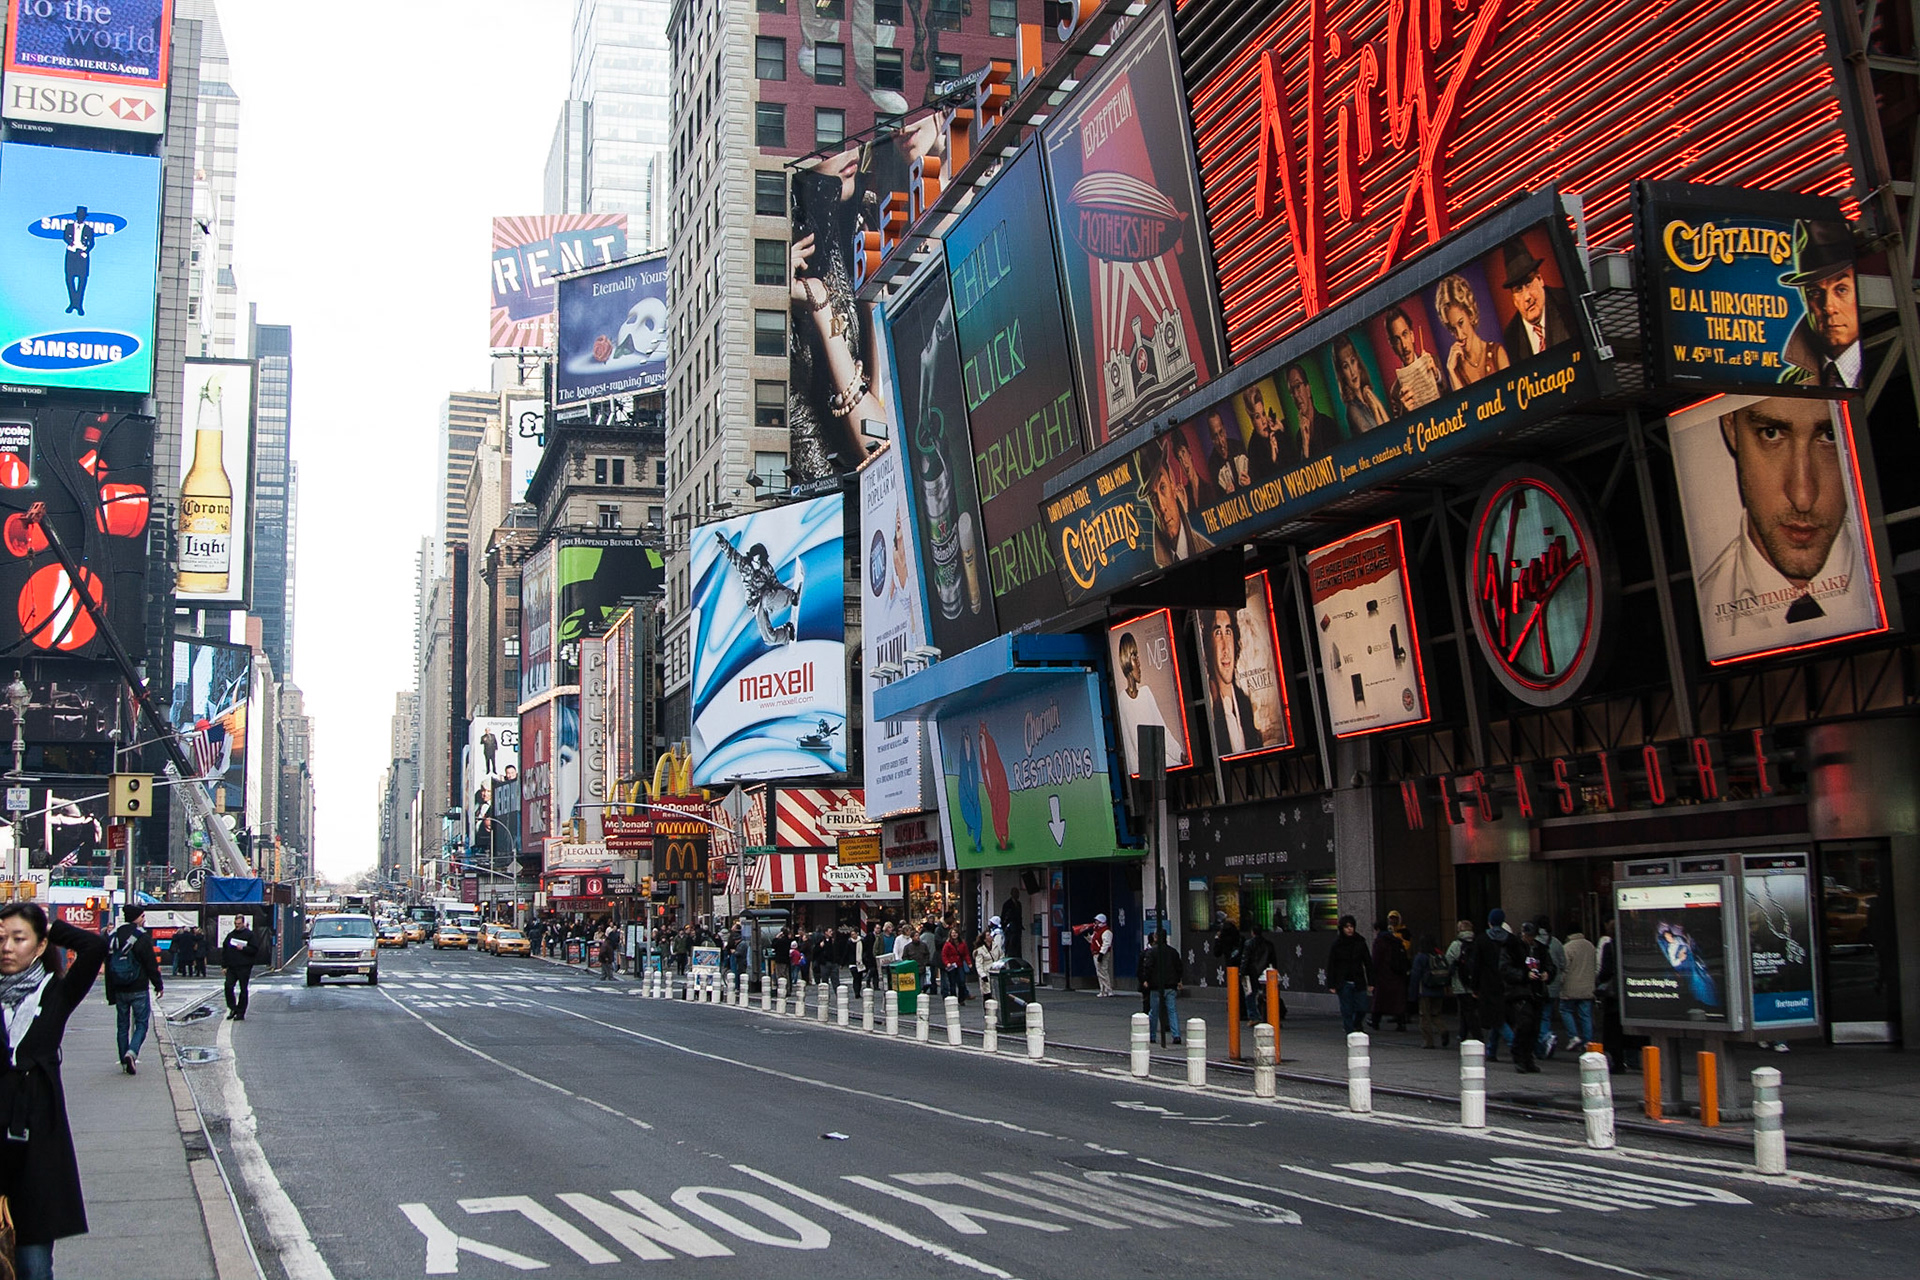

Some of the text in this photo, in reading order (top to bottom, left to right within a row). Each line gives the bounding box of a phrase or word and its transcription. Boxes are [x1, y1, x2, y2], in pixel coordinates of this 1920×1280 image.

[24, 0, 112, 24] to the
[66, 26, 156, 53] world
[12, 85, 104, 117] HSBC
[1079, 209, 1167, 259] MOTHERSHIP
[1663, 219, 1792, 272] CURTAINS
[493, 235, 615, 294] RENT
[951, 220, 1012, 321] CHILL
[593, 271, 667, 297] Eternally Yours
[1689, 289, 1789, 319] AL HIRSCHFELD
[1705, 316, 1767, 344] THEATRE
[19, 338, 123, 361] SAMSUNG
[1674, 345, 1783, 368] W. 45TH ST. at 8TH AVE.
[964, 318, 1026, 413] CLICK
[559, 388, 575, 400] The
[576, 373, 642, 398] longest-running
[976, 389, 1079, 505] DRAUGHT
[1201, 351, 1581, 535] THE MUSICAL COMEDY WHODUNIT from the creators of "Cabaret" and "Chicago"
[183, 500, 229, 515] Corona
[1047, 462, 1132, 524] DAVID HYDE PIERCE DEBRA MONK
[185, 536, 225, 556] Light
[574, 538, 608, 546] HAPPENED
[1062, 502, 1139, 589] CURTAINS
[988, 521, 1056, 598] DRINK
[1314, 556, 1392, 592] LOOKING FOR IN GAMES!
[1341, 552, 1361, 569] WHAT
[1380, 595, 1399, 607] PSP
[1715, 595, 1760, 617] JUSTIN
[1758, 574, 1850, 605] TIMBERLAKE
[739, 661, 814, 702] maxell
[759, 694, 814, 709] www.maxell.com
[1024, 699, 1061, 757] Charmin
[1013, 748, 1094, 791] RESTROOMS
[652, 802, 711, 813] McDonald's
[567, 848, 604, 856] LEGALLY
[1245, 854, 1256, 865] THE
[1256, 853, 1267, 865] GIFT
[1268, 852, 1276, 863] OF
[1276, 851, 1288, 862] HBO
[28, 872, 46, 882] Inc.
[65, 907, 94, 921] tkts
[398, 1186, 833, 1275] ONLY
